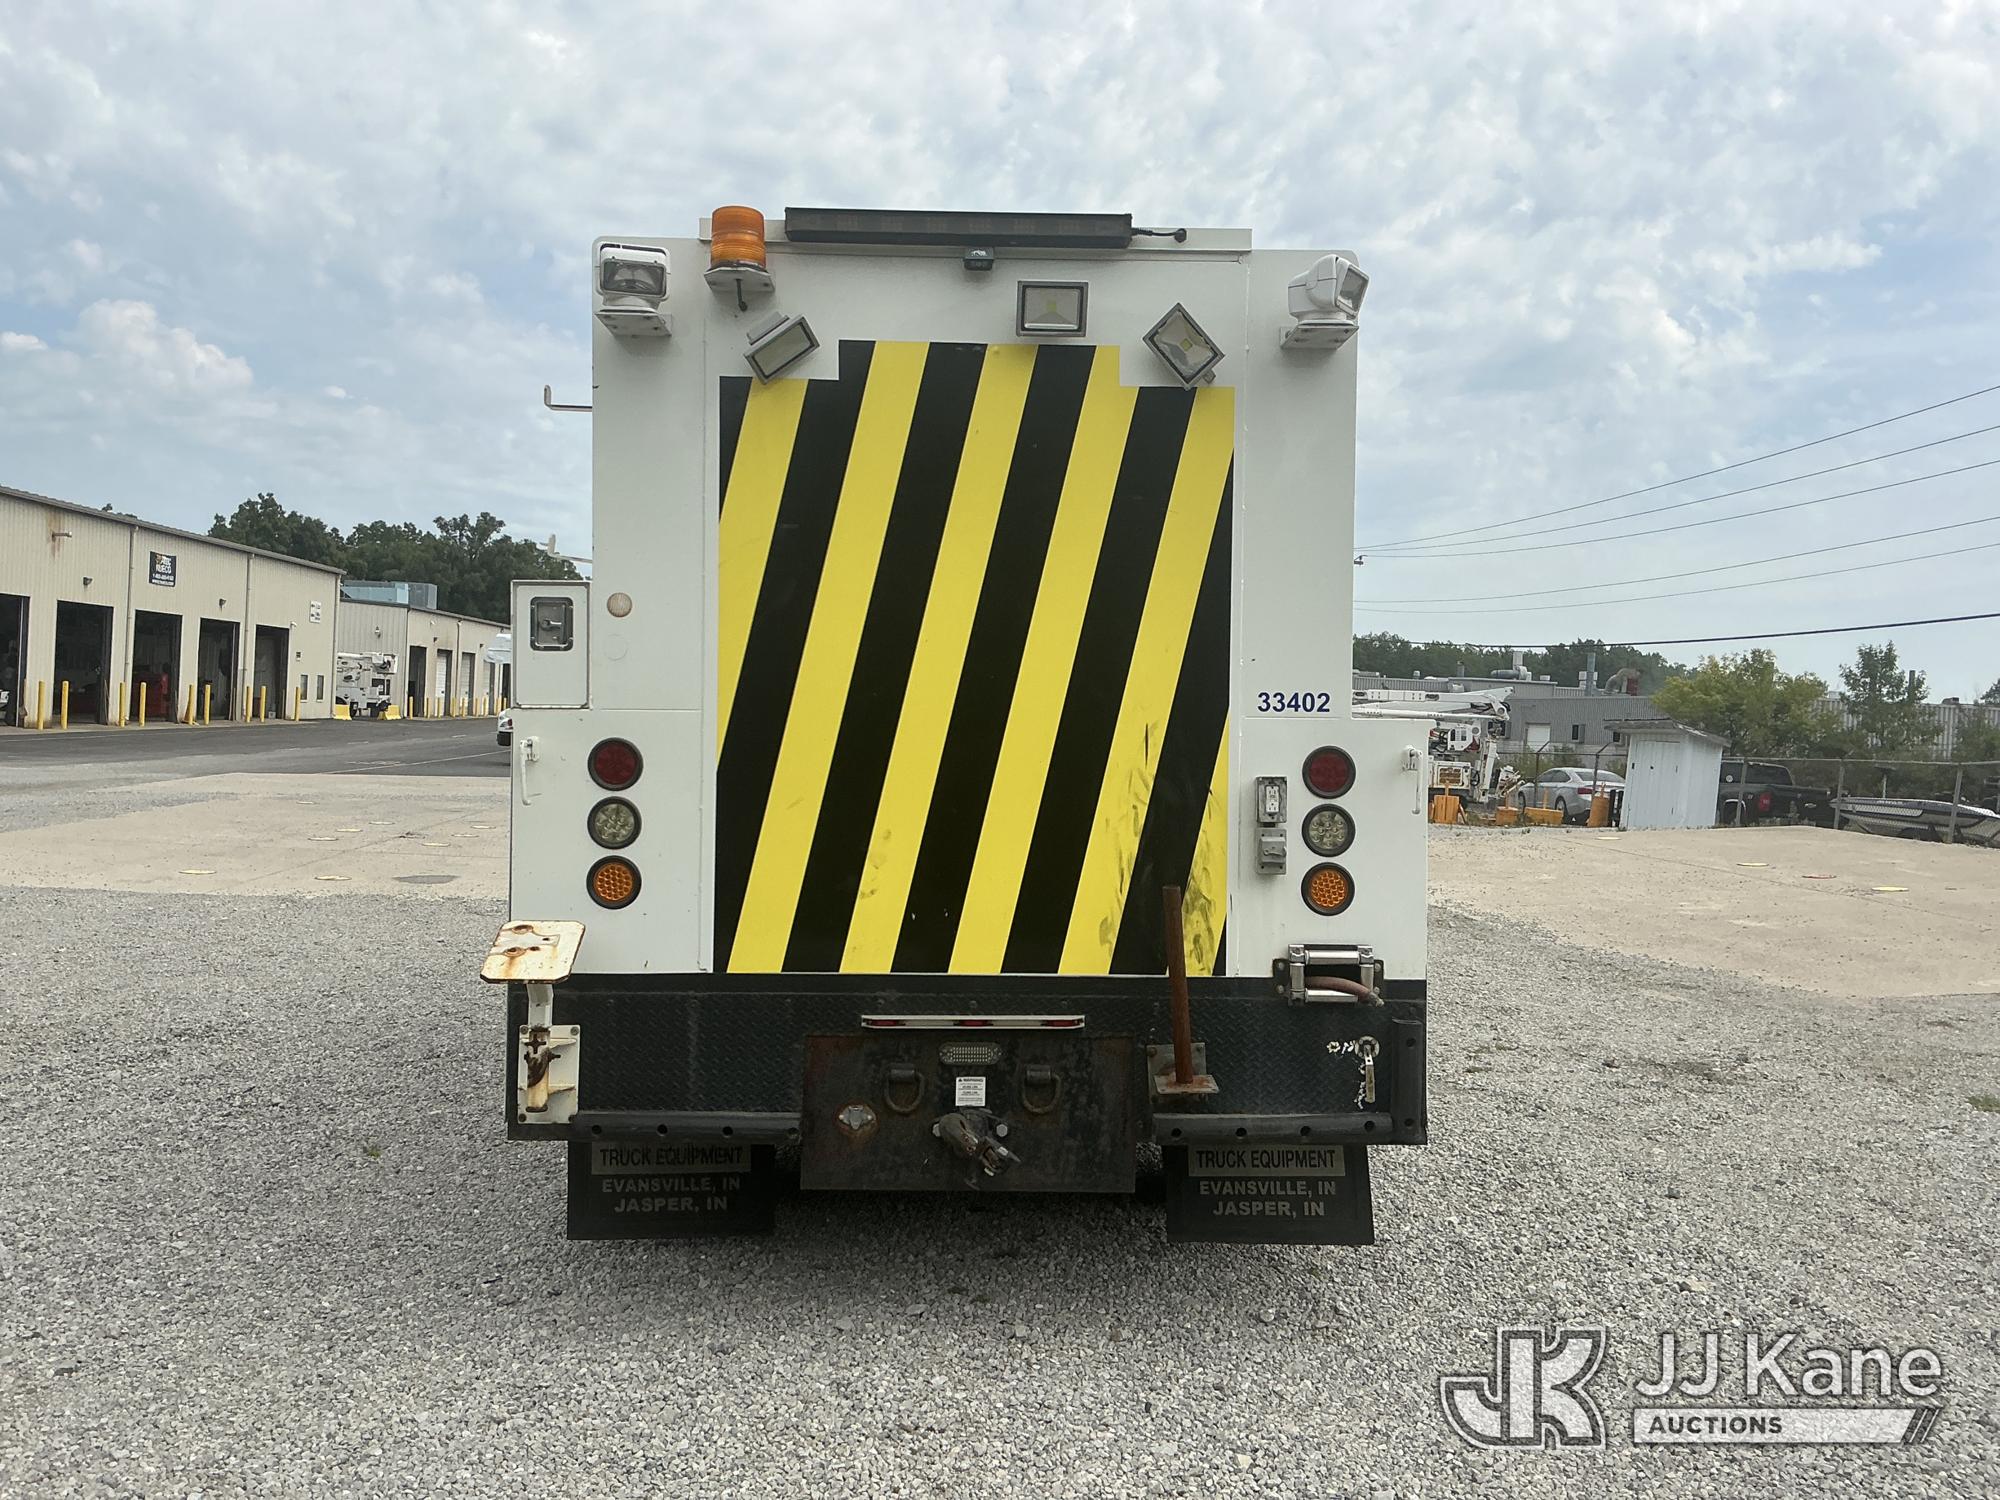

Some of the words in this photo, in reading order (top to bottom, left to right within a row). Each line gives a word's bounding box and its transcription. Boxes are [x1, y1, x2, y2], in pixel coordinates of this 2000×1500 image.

[1257, 691, 1330, 713] 33402
[600, 1148, 651, 1167] TRUCK
[655, 1145, 743, 1166] EQUIPMENT
[1196, 1150, 1247, 1169] TRUCK
[1251, 1150, 1336, 1169] EQUIPMENT
[602, 1176, 716, 1193] EVANSVILLE,
[722, 1175, 741, 1192] IN
[1200, 1180, 1313, 1198] EVANSVILLE,
[1318, 1180, 1337, 1196] IN
[614, 1197, 700, 1214] JASPER,
[707, 1196, 728, 1211] IN
[1213, 1201, 1297, 1219] JASPER,
[1303, 1201, 1325, 1217] IN
